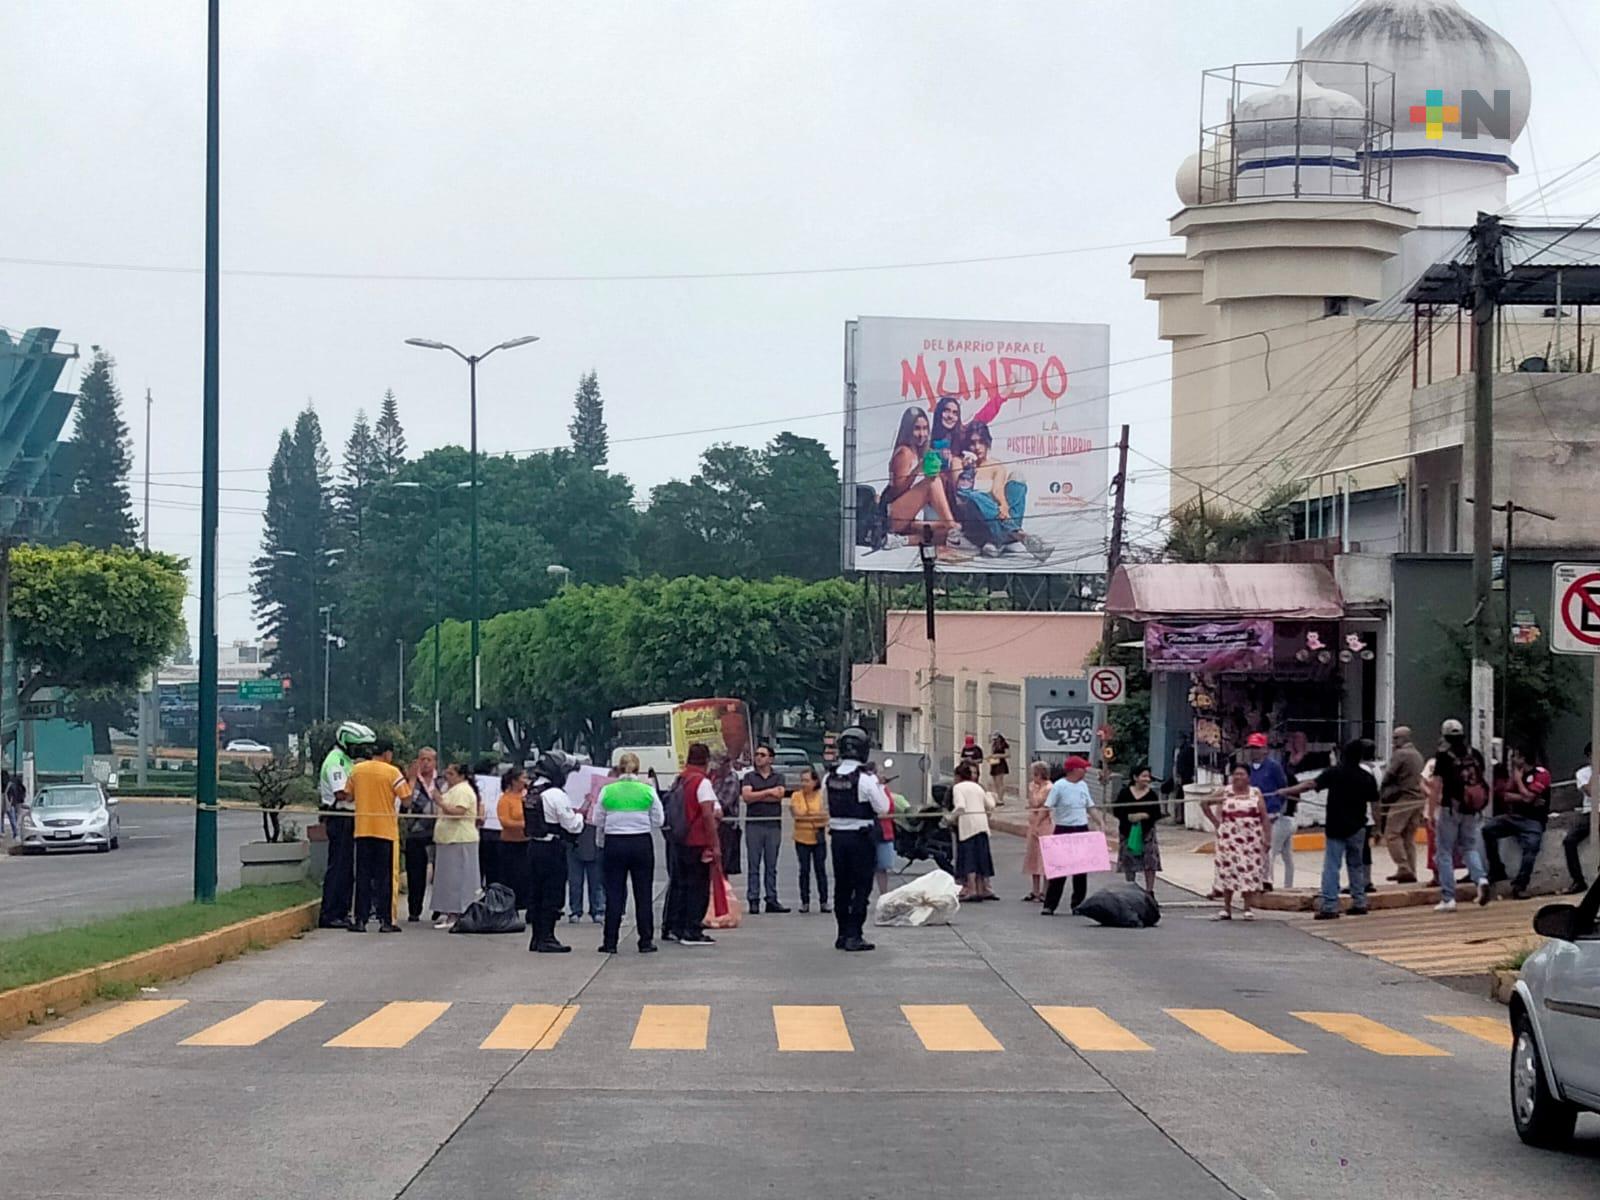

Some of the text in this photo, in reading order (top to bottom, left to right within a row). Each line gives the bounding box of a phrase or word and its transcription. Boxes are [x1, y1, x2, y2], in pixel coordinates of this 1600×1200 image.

[923, 339, 945, 350] DEL
[997, 341, 1030, 355] PARA
[1033, 342, 1046, 354] EL
[901, 352, 1068, 413] MUNDO
[1042, 421, 1060, 431] LA
[1057, 728, 1092, 746] 250
